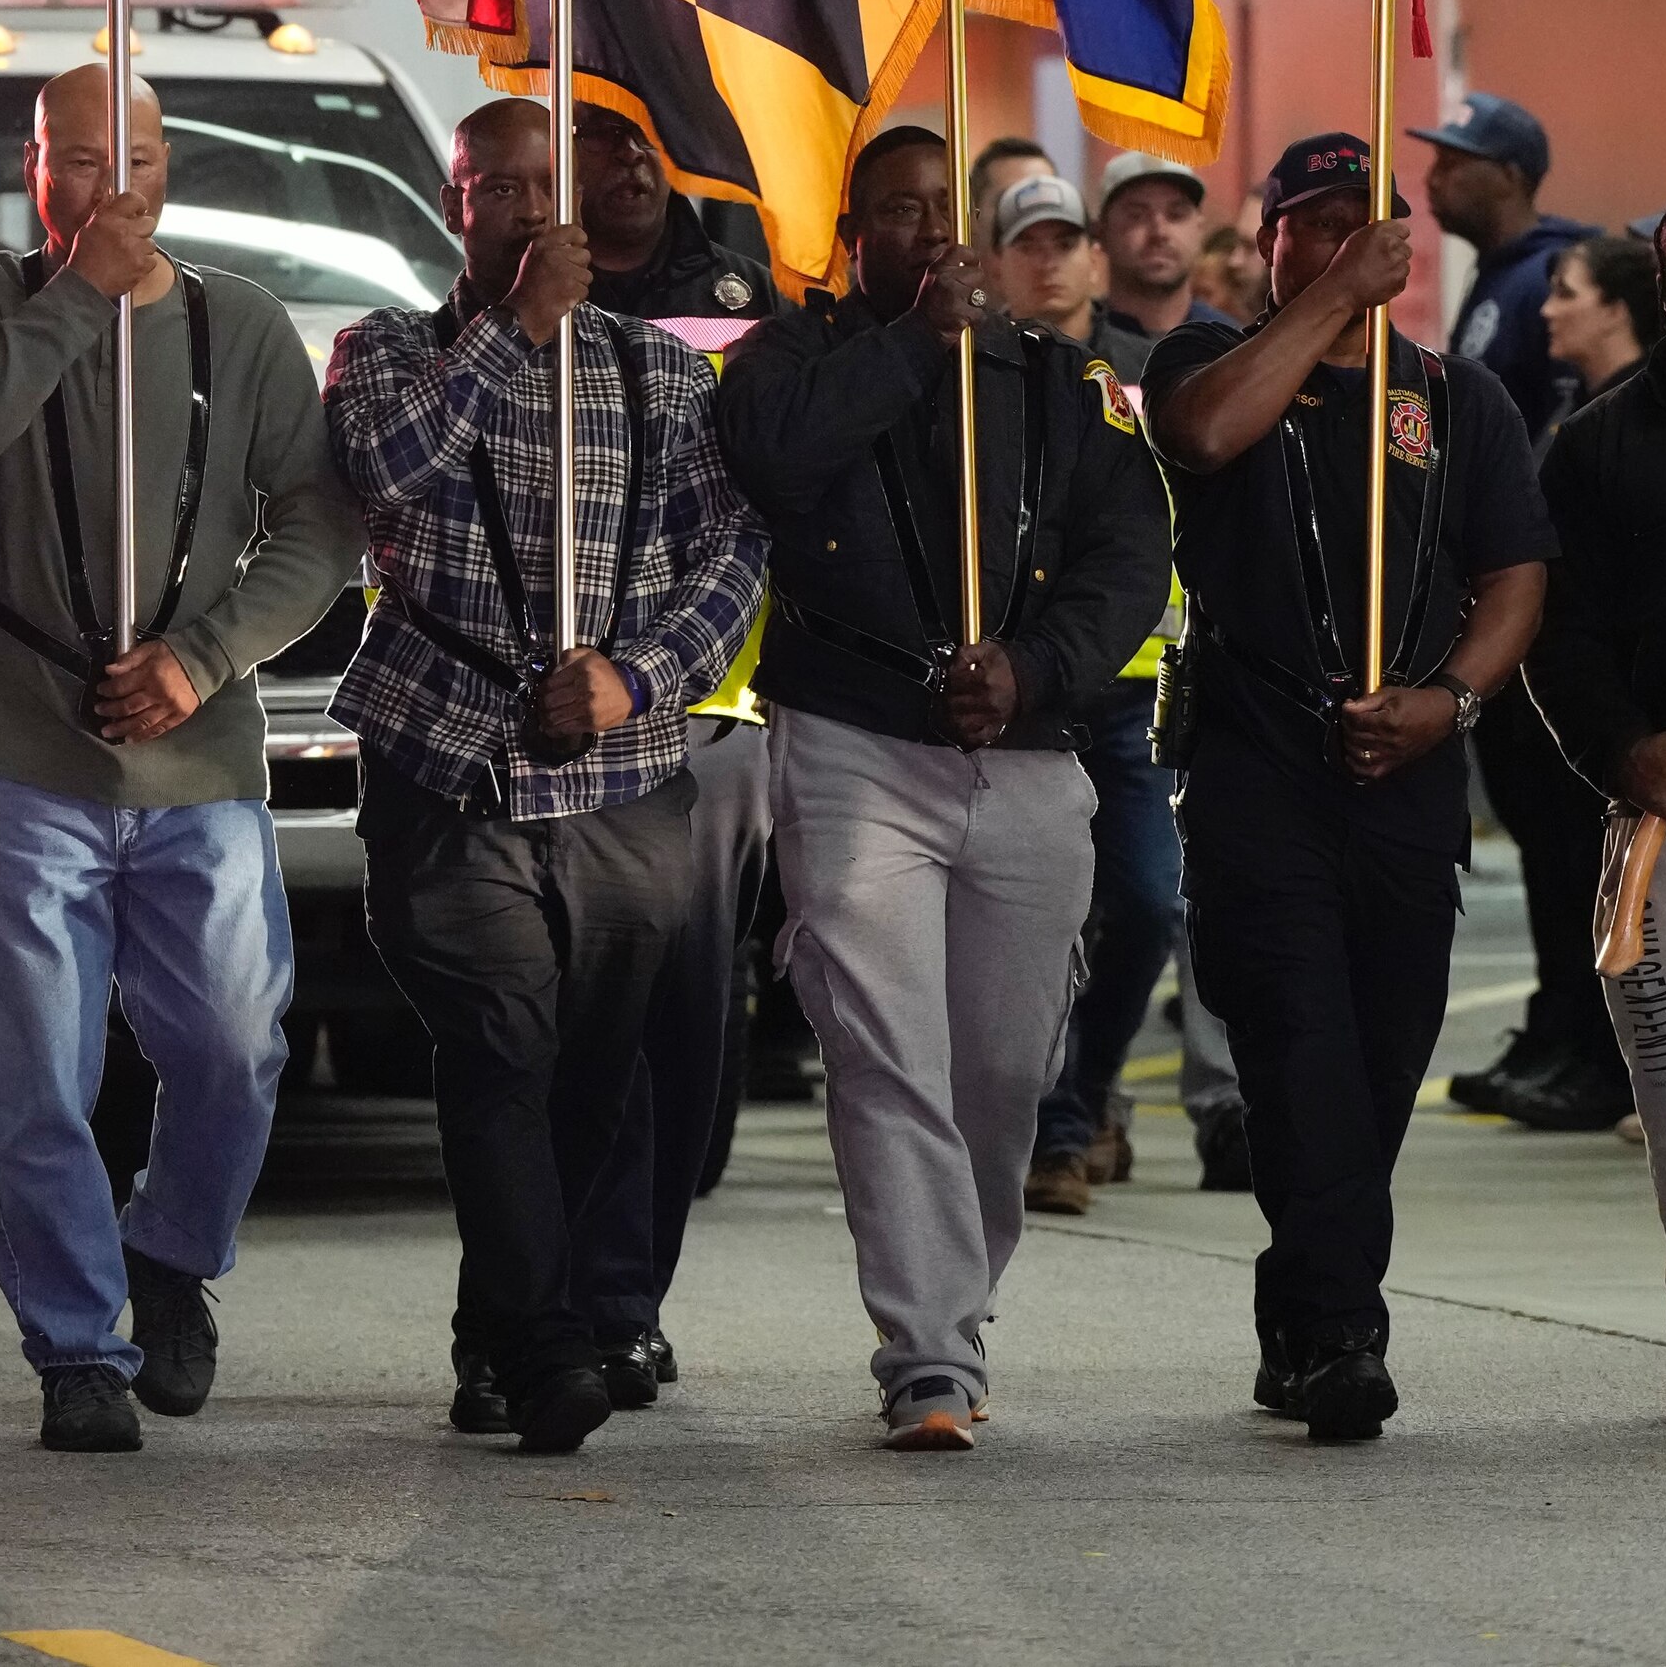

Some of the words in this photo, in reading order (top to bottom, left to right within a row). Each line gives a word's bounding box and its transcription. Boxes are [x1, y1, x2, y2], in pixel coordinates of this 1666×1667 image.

[1307, 151, 1338, 173] BC
[1295, 392, 1325, 408] RSON
[1388, 442, 1405, 460] FIRE
[1405, 452, 1430, 470] SERVIC
